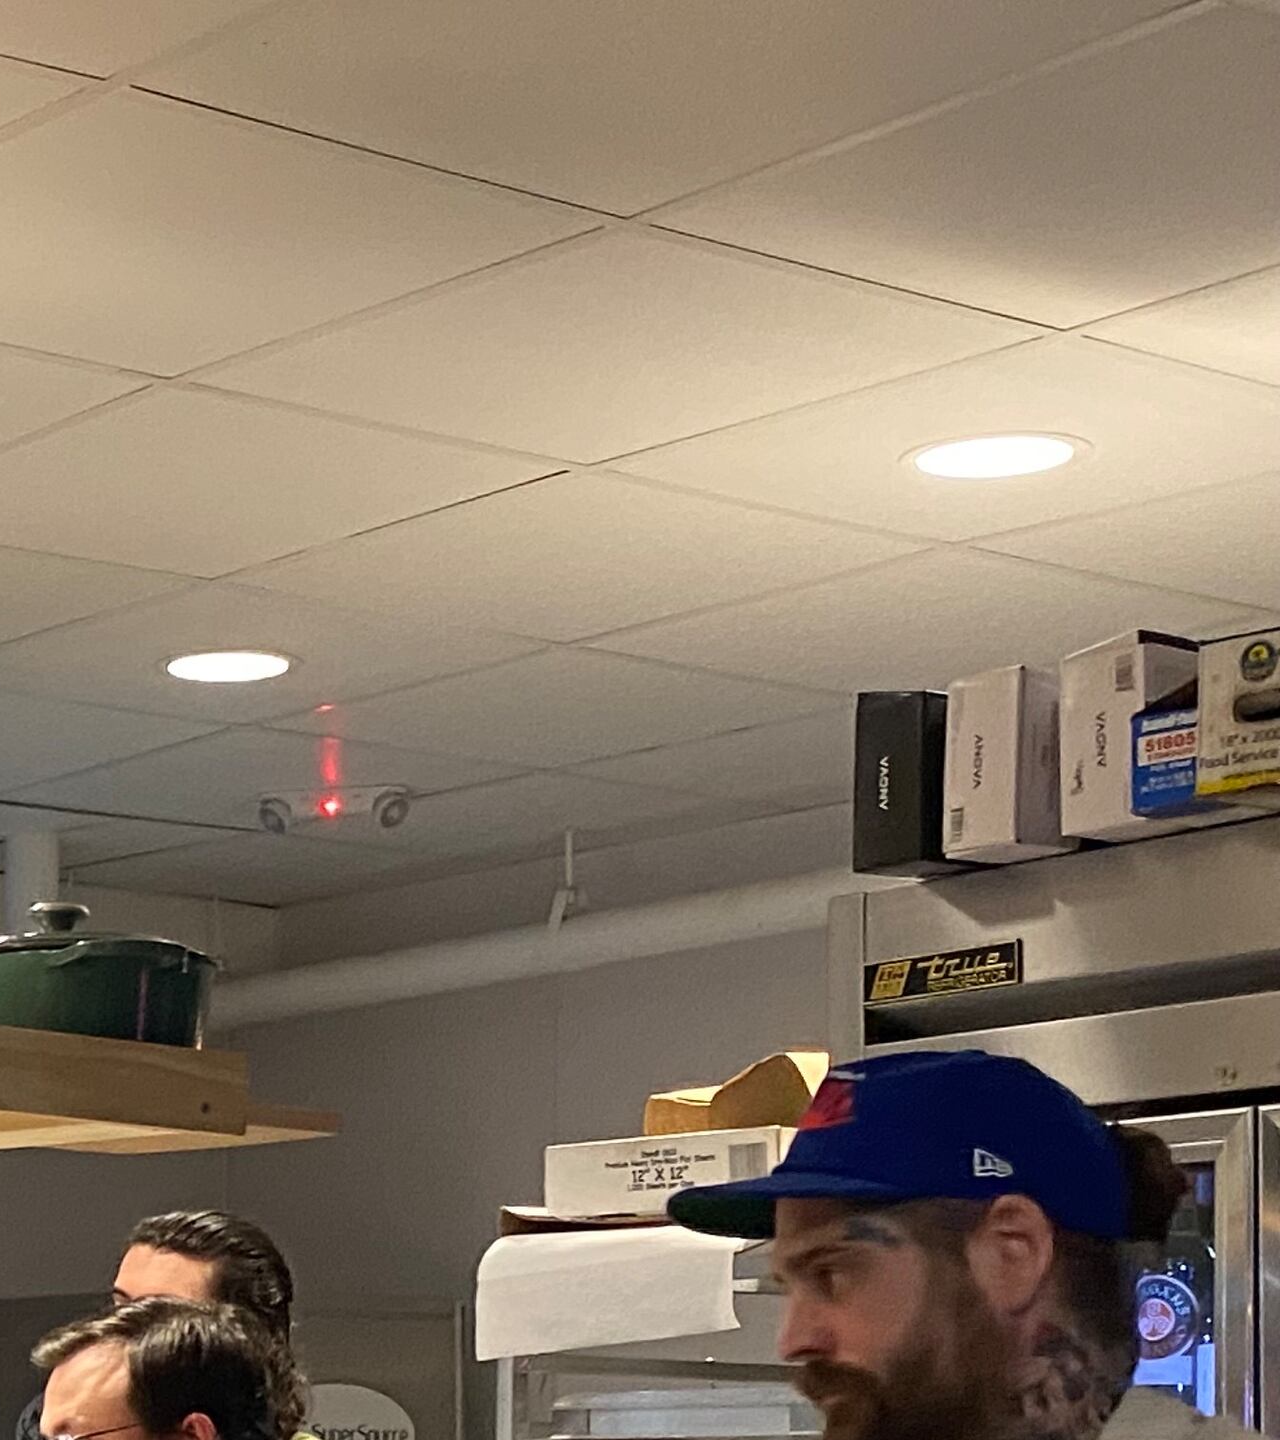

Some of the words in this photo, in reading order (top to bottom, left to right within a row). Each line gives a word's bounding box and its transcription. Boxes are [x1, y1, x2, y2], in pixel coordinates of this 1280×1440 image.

[972, 734, 984, 790] ANOVA
[1095, 711, 1108, 769] ANOVA
[878, 756, 889, 810] ANOVA
